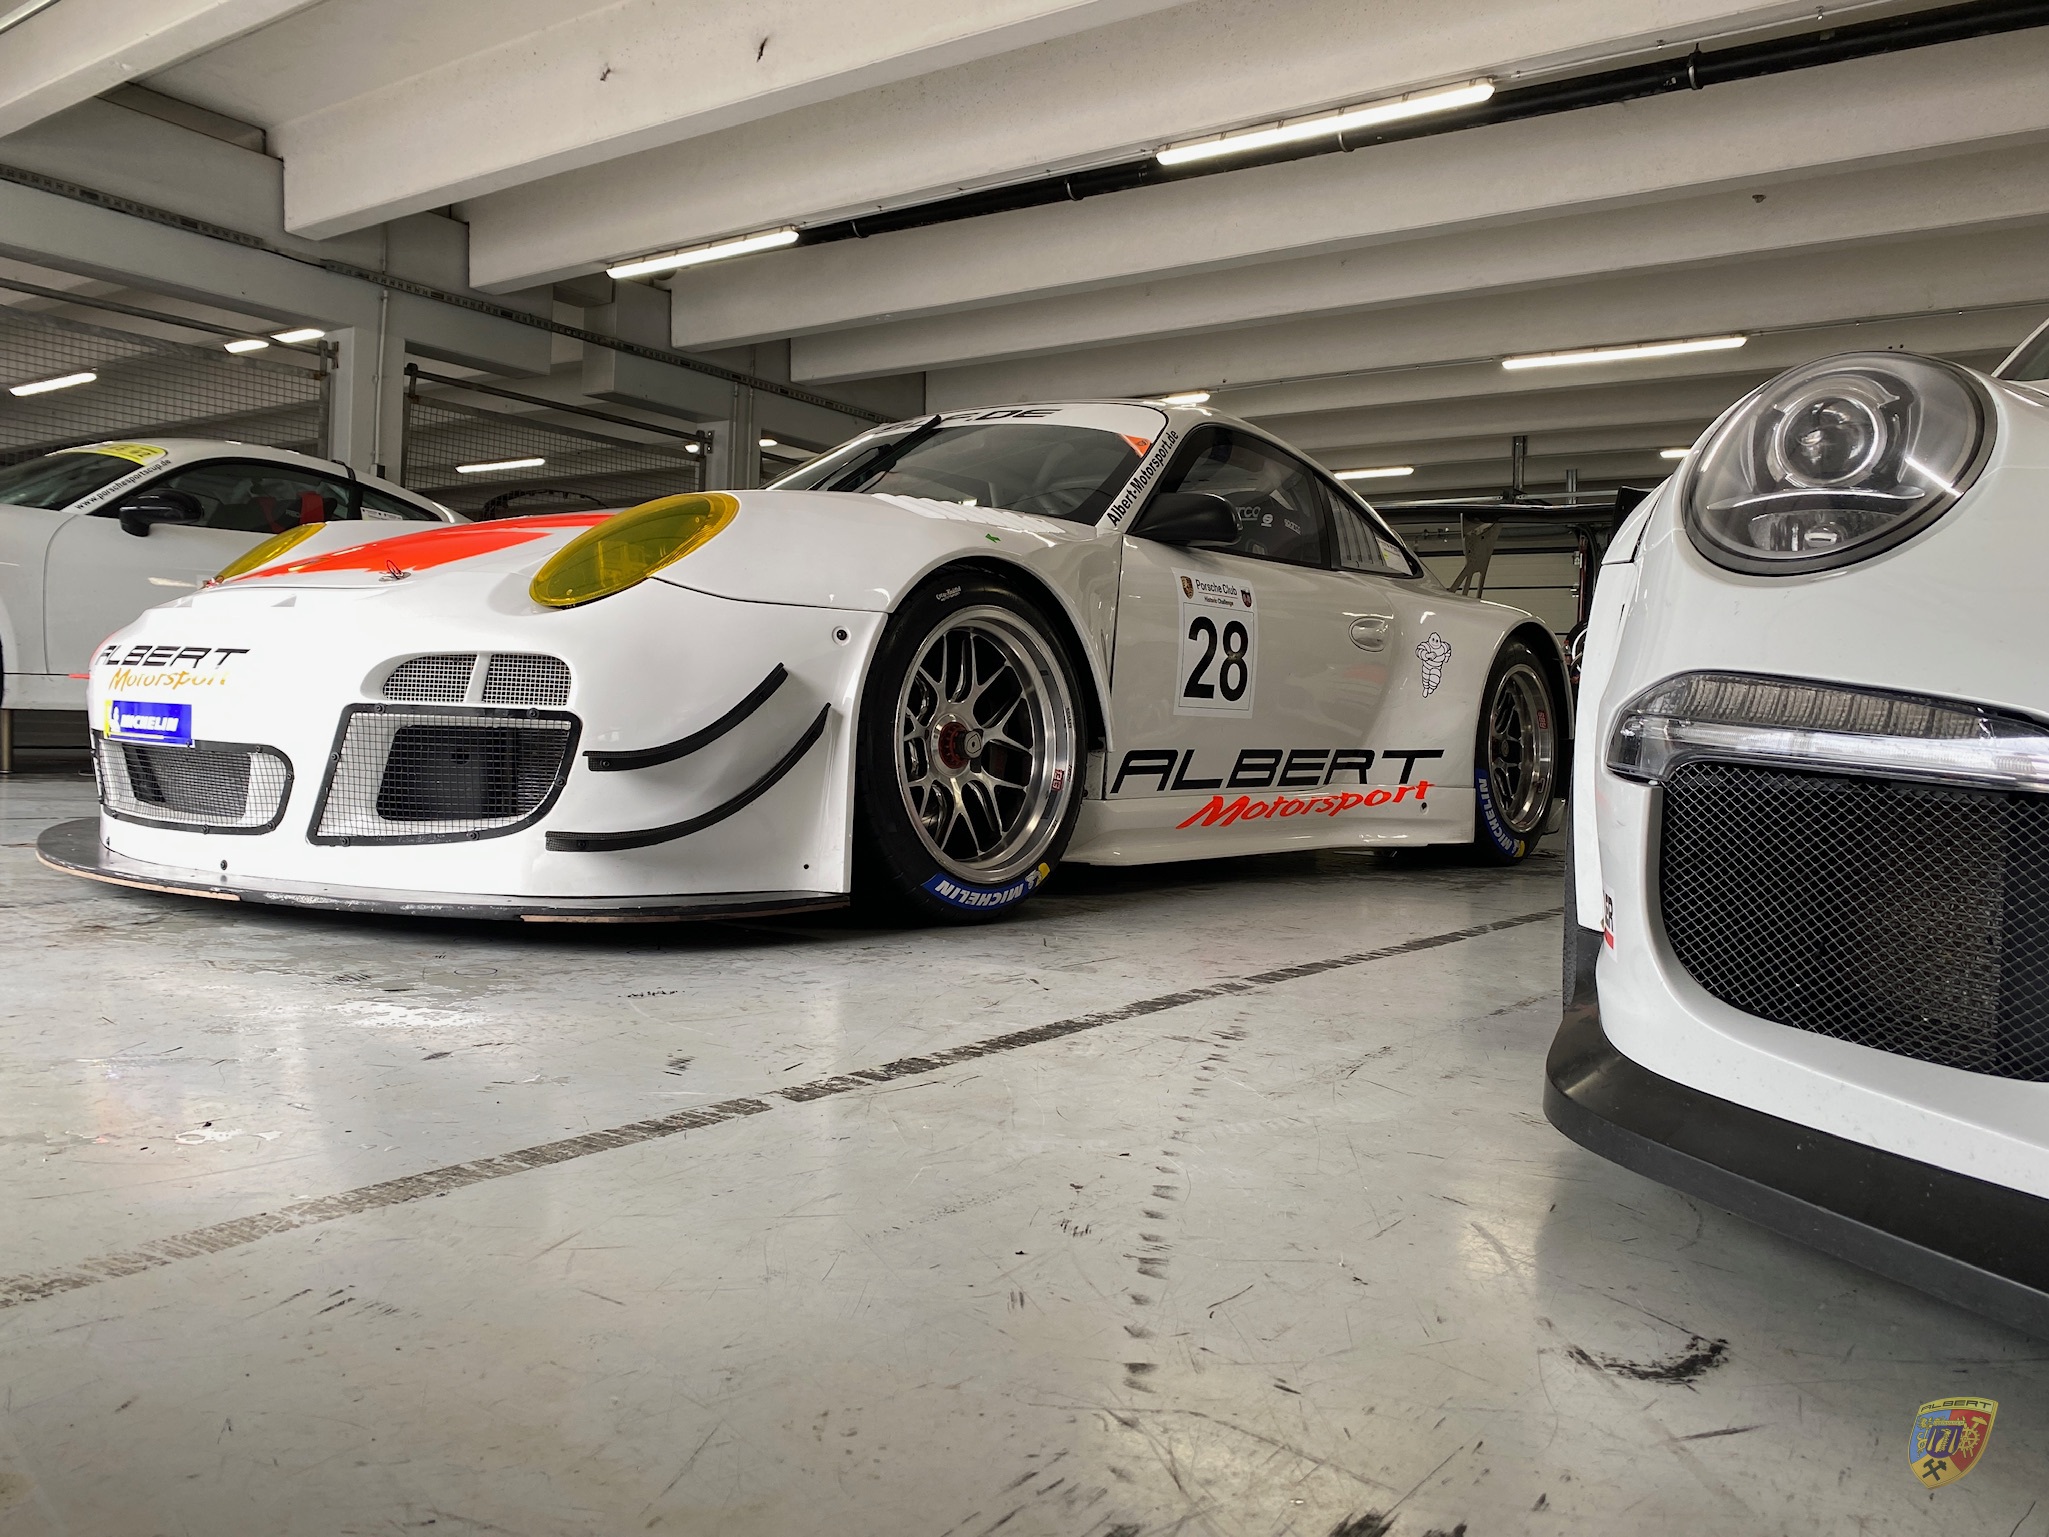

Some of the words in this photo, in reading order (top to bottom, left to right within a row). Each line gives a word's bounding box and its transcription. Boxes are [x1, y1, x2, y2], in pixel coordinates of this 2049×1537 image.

[74, 459, 171, 510] www.porschesportscup.de
[1106, 430, 1179, 527] Albert-Motorsport.de
[1195, 579, 1222, 593] Porsche
[1222, 584, 1238, 596] Club
[96, 645, 251, 669] ALBERT
[1183, 616, 1249, 702] 28
[120, 714, 180, 732] MICHELIN
[1110, 749, 1445, 794] ALBERT
[1175, 781, 1435, 829] Motorsport
[1478, 778, 1513, 850] MICHELIN
[935, 880, 1025, 907] MICHELIN
